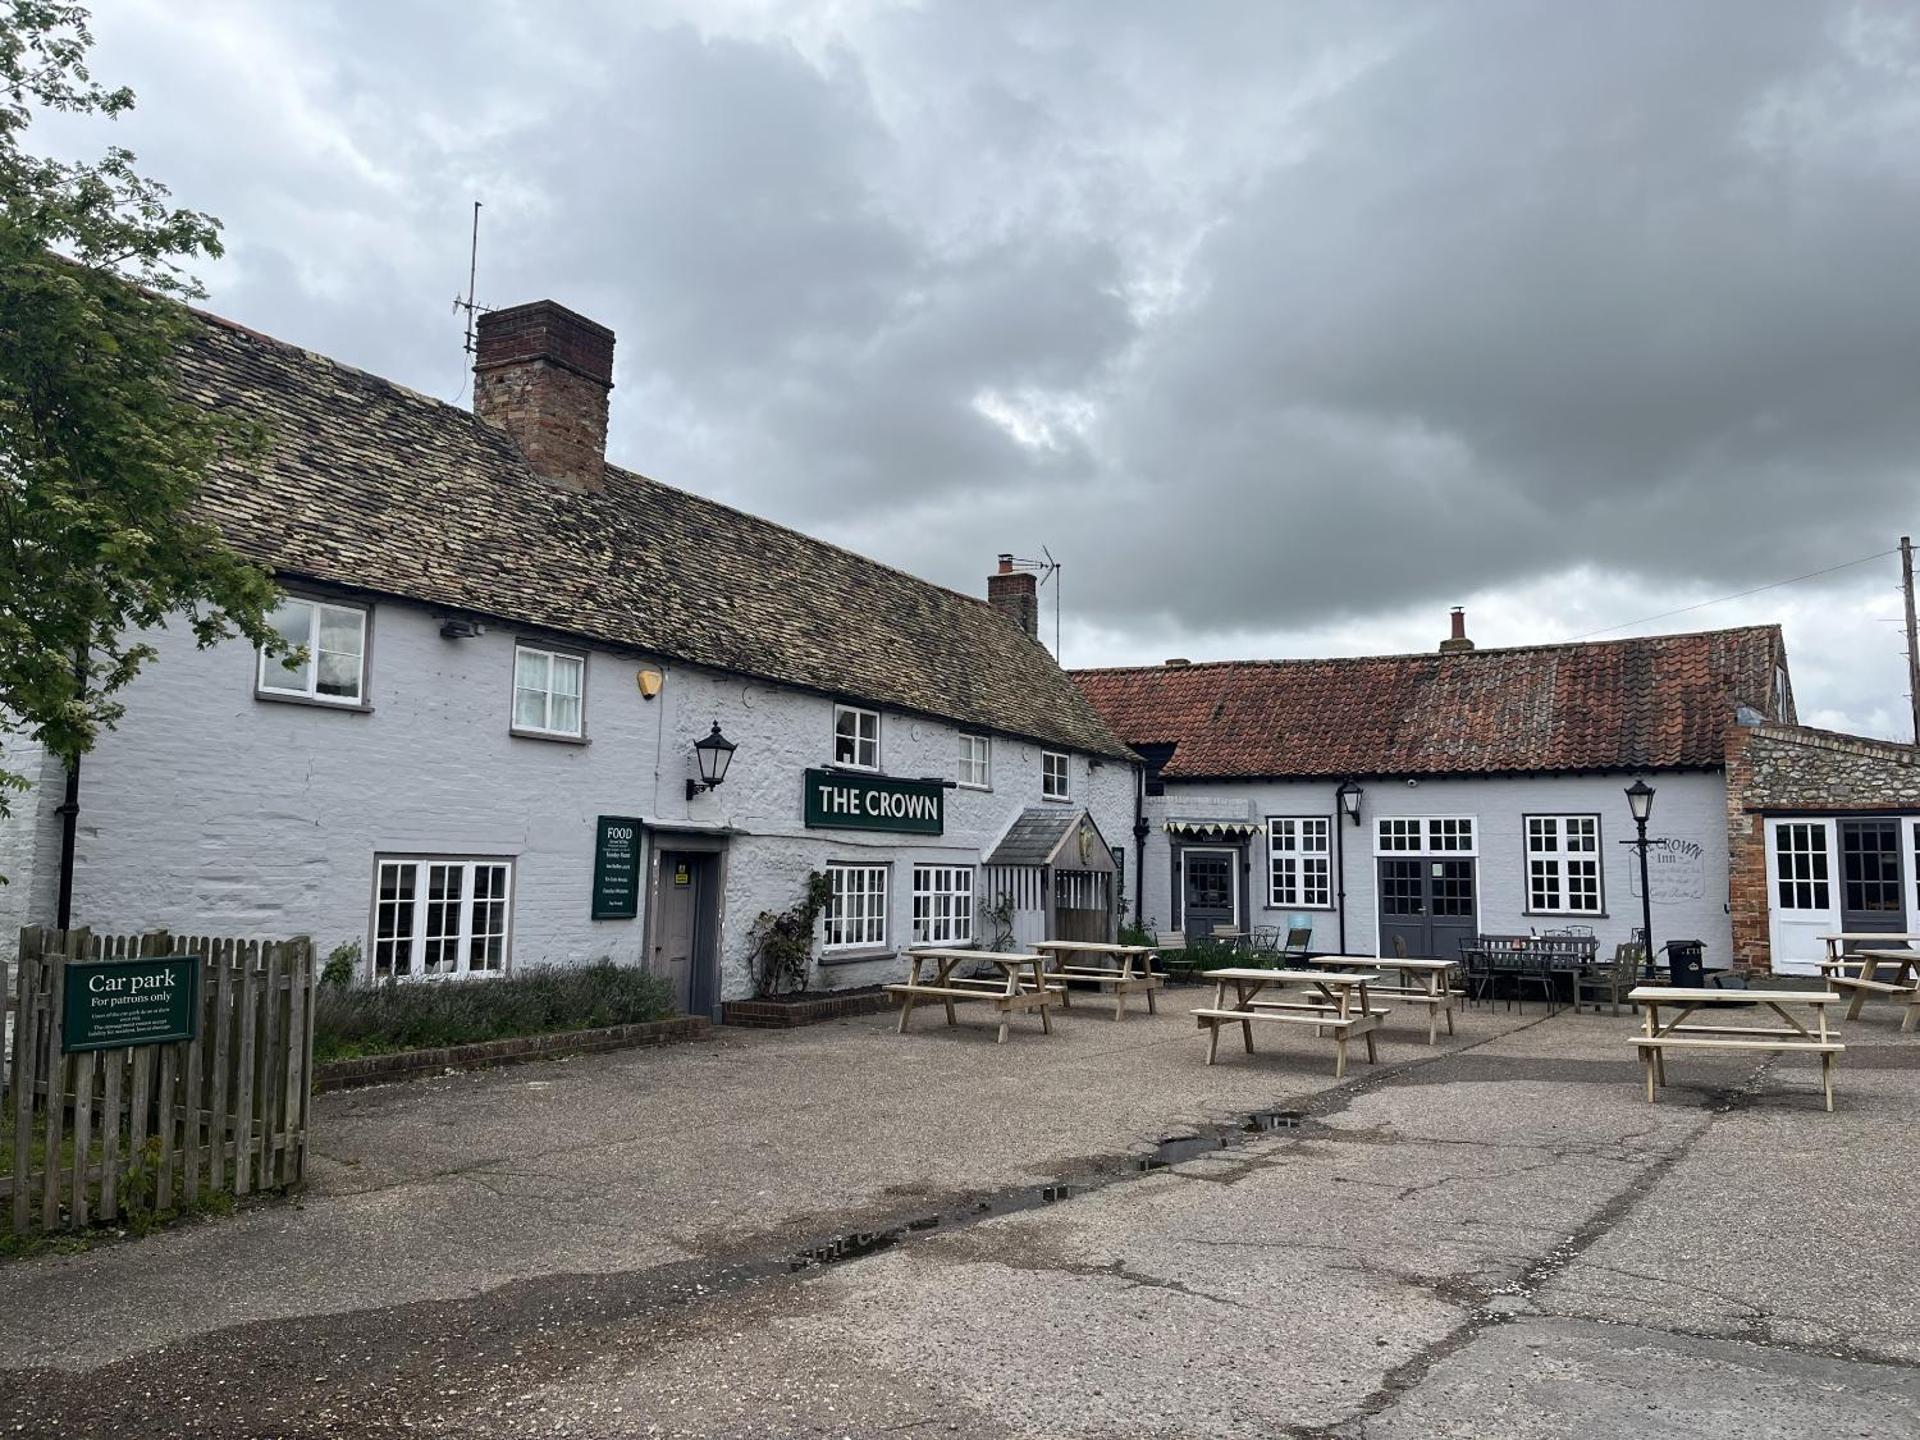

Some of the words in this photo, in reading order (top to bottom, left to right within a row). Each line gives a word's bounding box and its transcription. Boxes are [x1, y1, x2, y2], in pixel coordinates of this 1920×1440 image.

[818, 785, 861, 815] THE
[865, 790, 938, 821] CROWN
[607, 828, 632, 839] FOOD
[1656, 837, 1705, 860] CROWN
[1657, 853, 1676, 864] Inn
[89, 975, 126, 992] Car
[130, 969, 175, 993] park
[91, 997, 109, 1007] For
[110, 995, 149, 1007] patrons
[150, 991, 172, 1003] only
